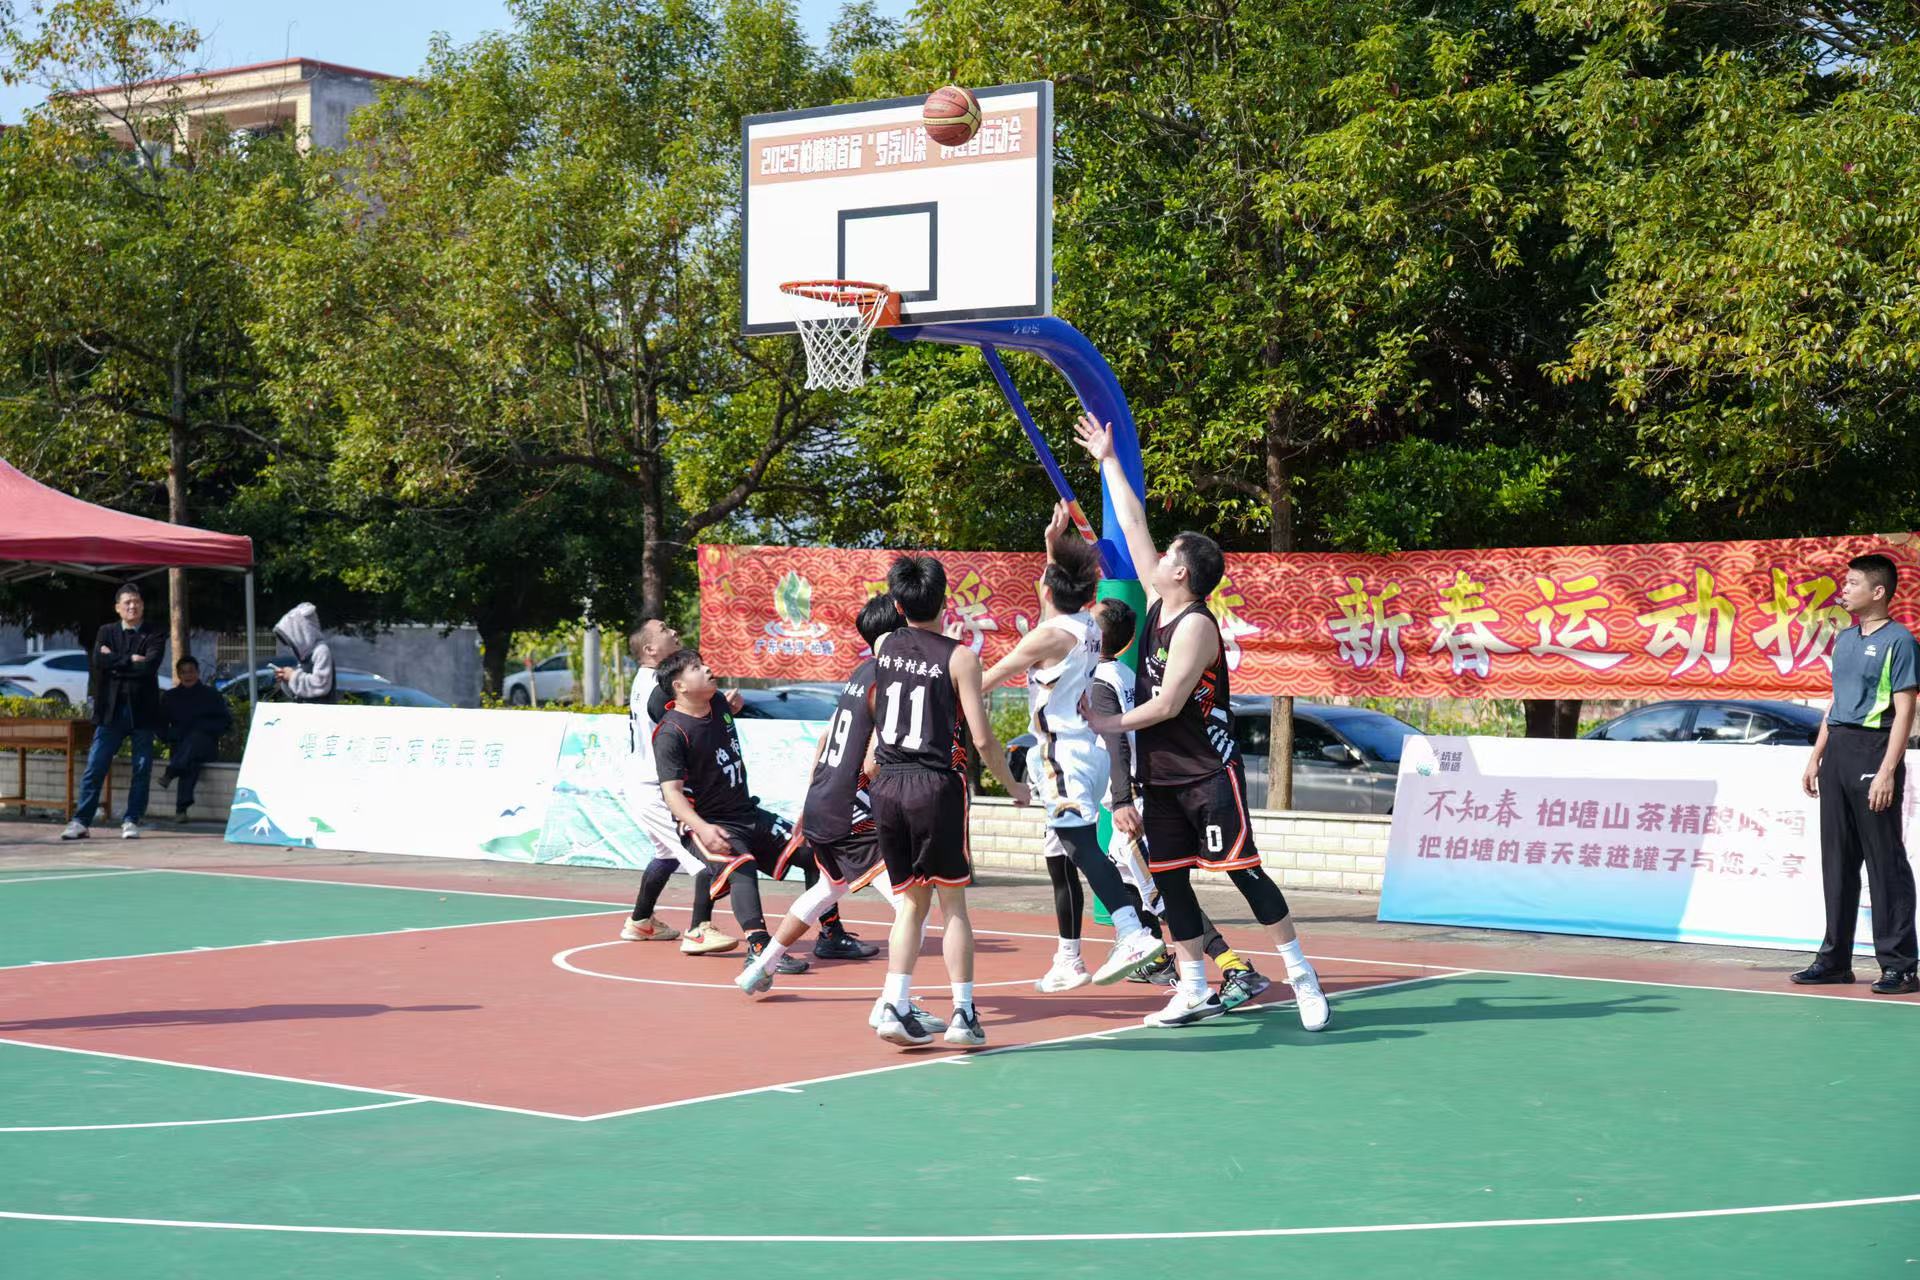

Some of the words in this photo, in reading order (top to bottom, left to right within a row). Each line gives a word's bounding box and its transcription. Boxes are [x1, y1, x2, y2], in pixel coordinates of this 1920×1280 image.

[878, 655, 943, 678] 柏市村委会
[881, 681, 926, 751] 11
[723, 760, 743, 788] 77
[1424, 789, 1524, 828] 不知春
[1206, 825, 1223, 852] 0
